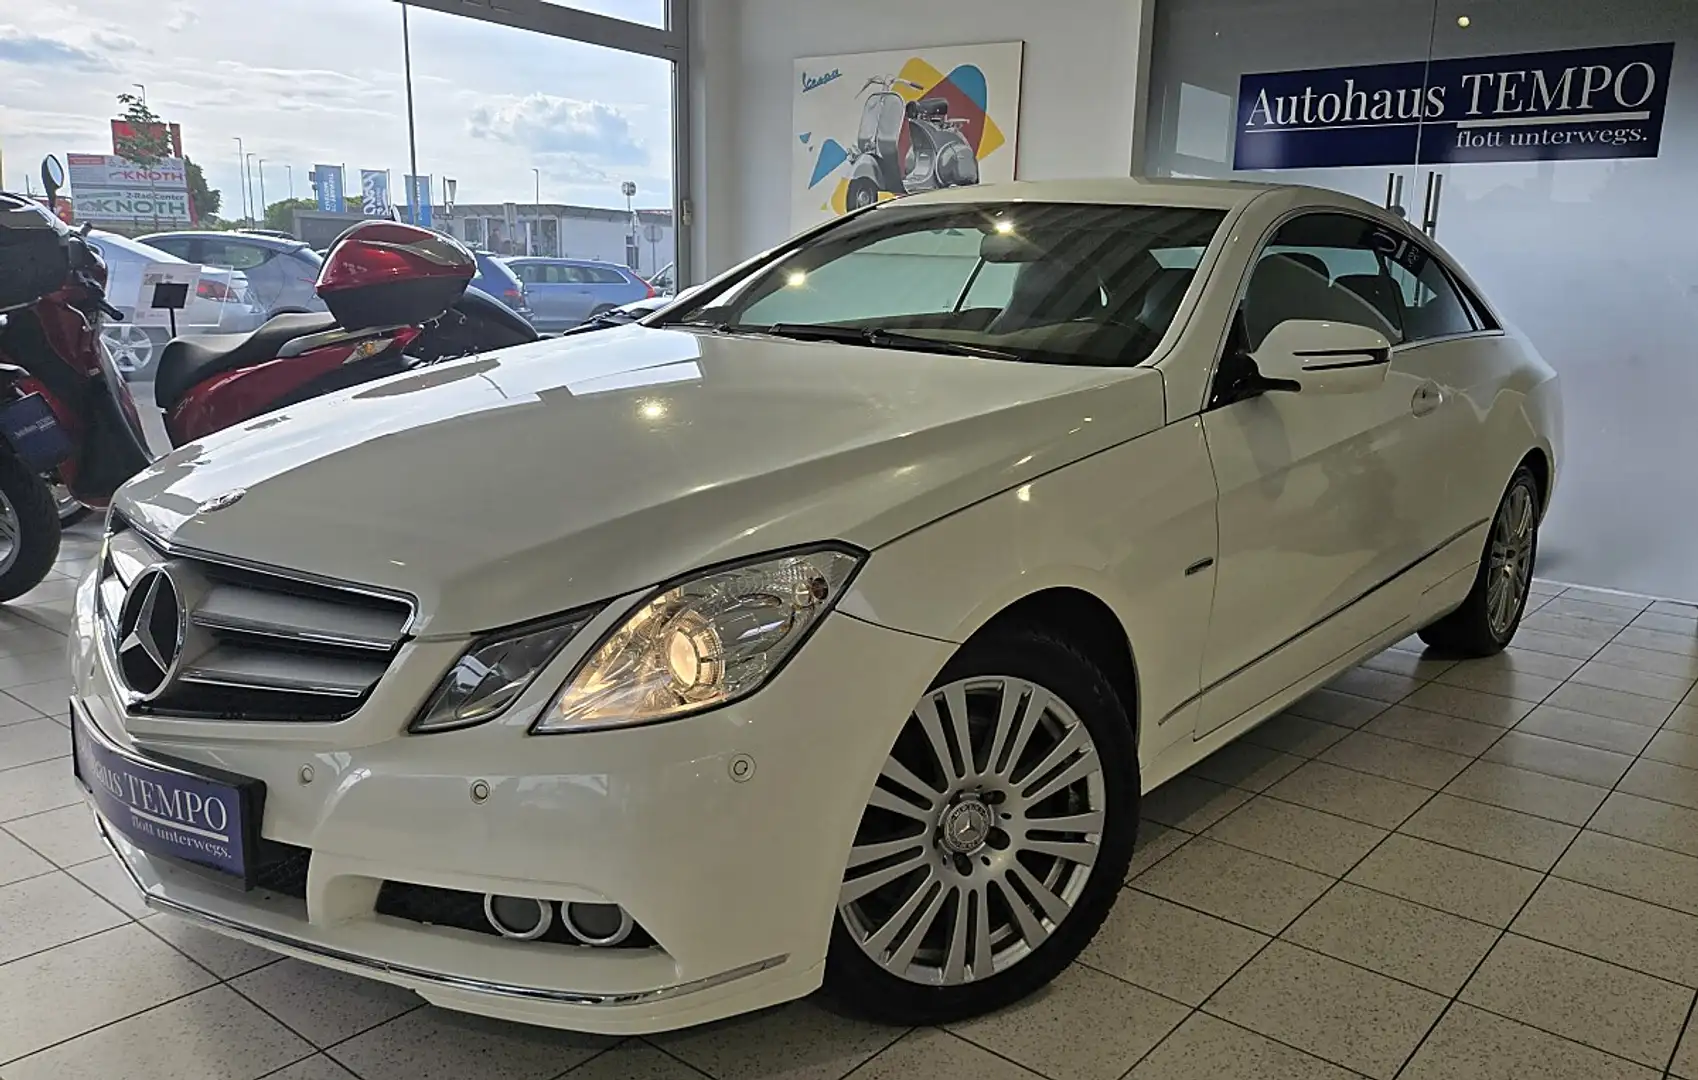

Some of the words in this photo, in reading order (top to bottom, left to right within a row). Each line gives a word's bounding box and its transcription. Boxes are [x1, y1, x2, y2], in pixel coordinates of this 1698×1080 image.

[802, 67, 843, 93] Vespa
[1246, 79, 1447, 127] Autohaus
[1460, 61, 1657, 116] TEMPO
[1456, 129, 1503, 149] flott
[1510, 125, 1648, 146] unterwegs.
[123, 170, 183, 181] KNOTH
[97, 200, 186, 214] KNOTH
[124, 773, 227, 831] TEMPO
[157, 828, 232, 859] unterwegs.
